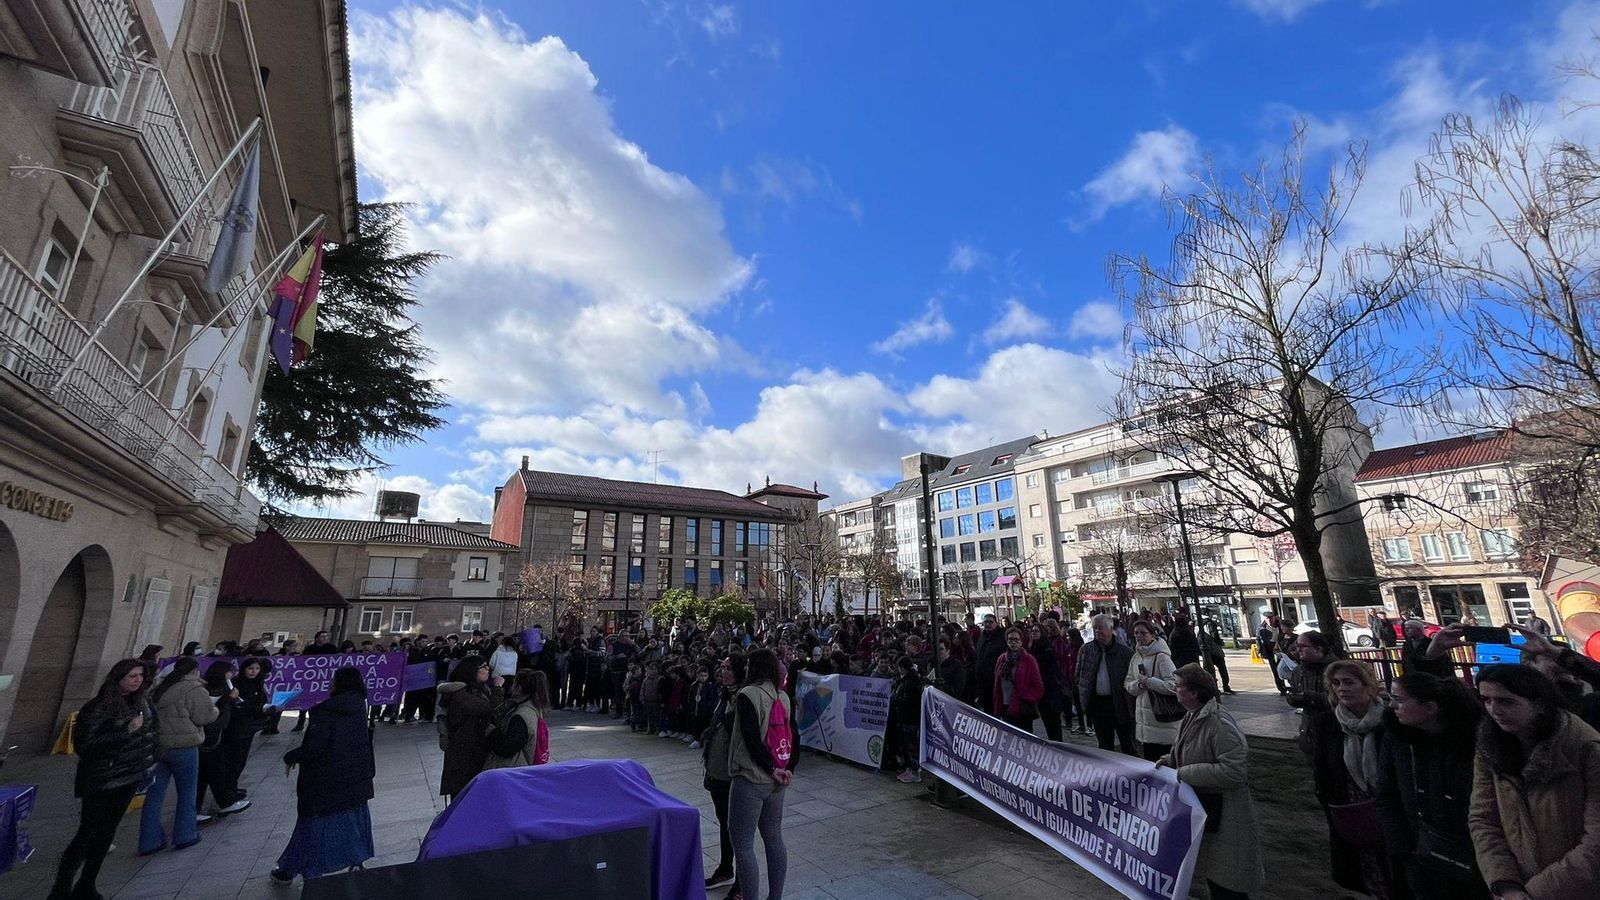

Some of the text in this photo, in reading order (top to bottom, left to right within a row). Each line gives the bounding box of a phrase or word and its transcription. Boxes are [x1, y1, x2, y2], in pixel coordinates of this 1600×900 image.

[263, 682, 304, 694] NCIA
[310, 680, 330, 692] DE
[365, 676, 398, 689] ERO
[271, 658, 296, 669] SA
[304, 654, 388, 668] COMARCA
[292, 668, 336, 681] CONT
[365, 666, 377, 677] A
[952, 712, 998, 746] FEMURO
[998, 729, 1008, 751] E
[1008, 735, 1027, 759] AS
[1027, 742, 1060, 774] SUAS
[1060, 759, 1170, 821] ASOCIACIÓNS
[952, 735, 993, 771] CONTRA
[991, 755, 1002, 777] A
[1002, 759, 1068, 811] VIOLENCIA
[1072, 789, 1093, 823] DE
[1097, 799, 1160, 857] XÉNERO
[1019, 795, 1044, 825] POLA
[1046, 810, 1104, 859] IGUALDADE
[1105, 843, 1113, 865] E
[1113, 849, 1122, 871] A
[1123, 853, 1175, 898] XUSTIZ
